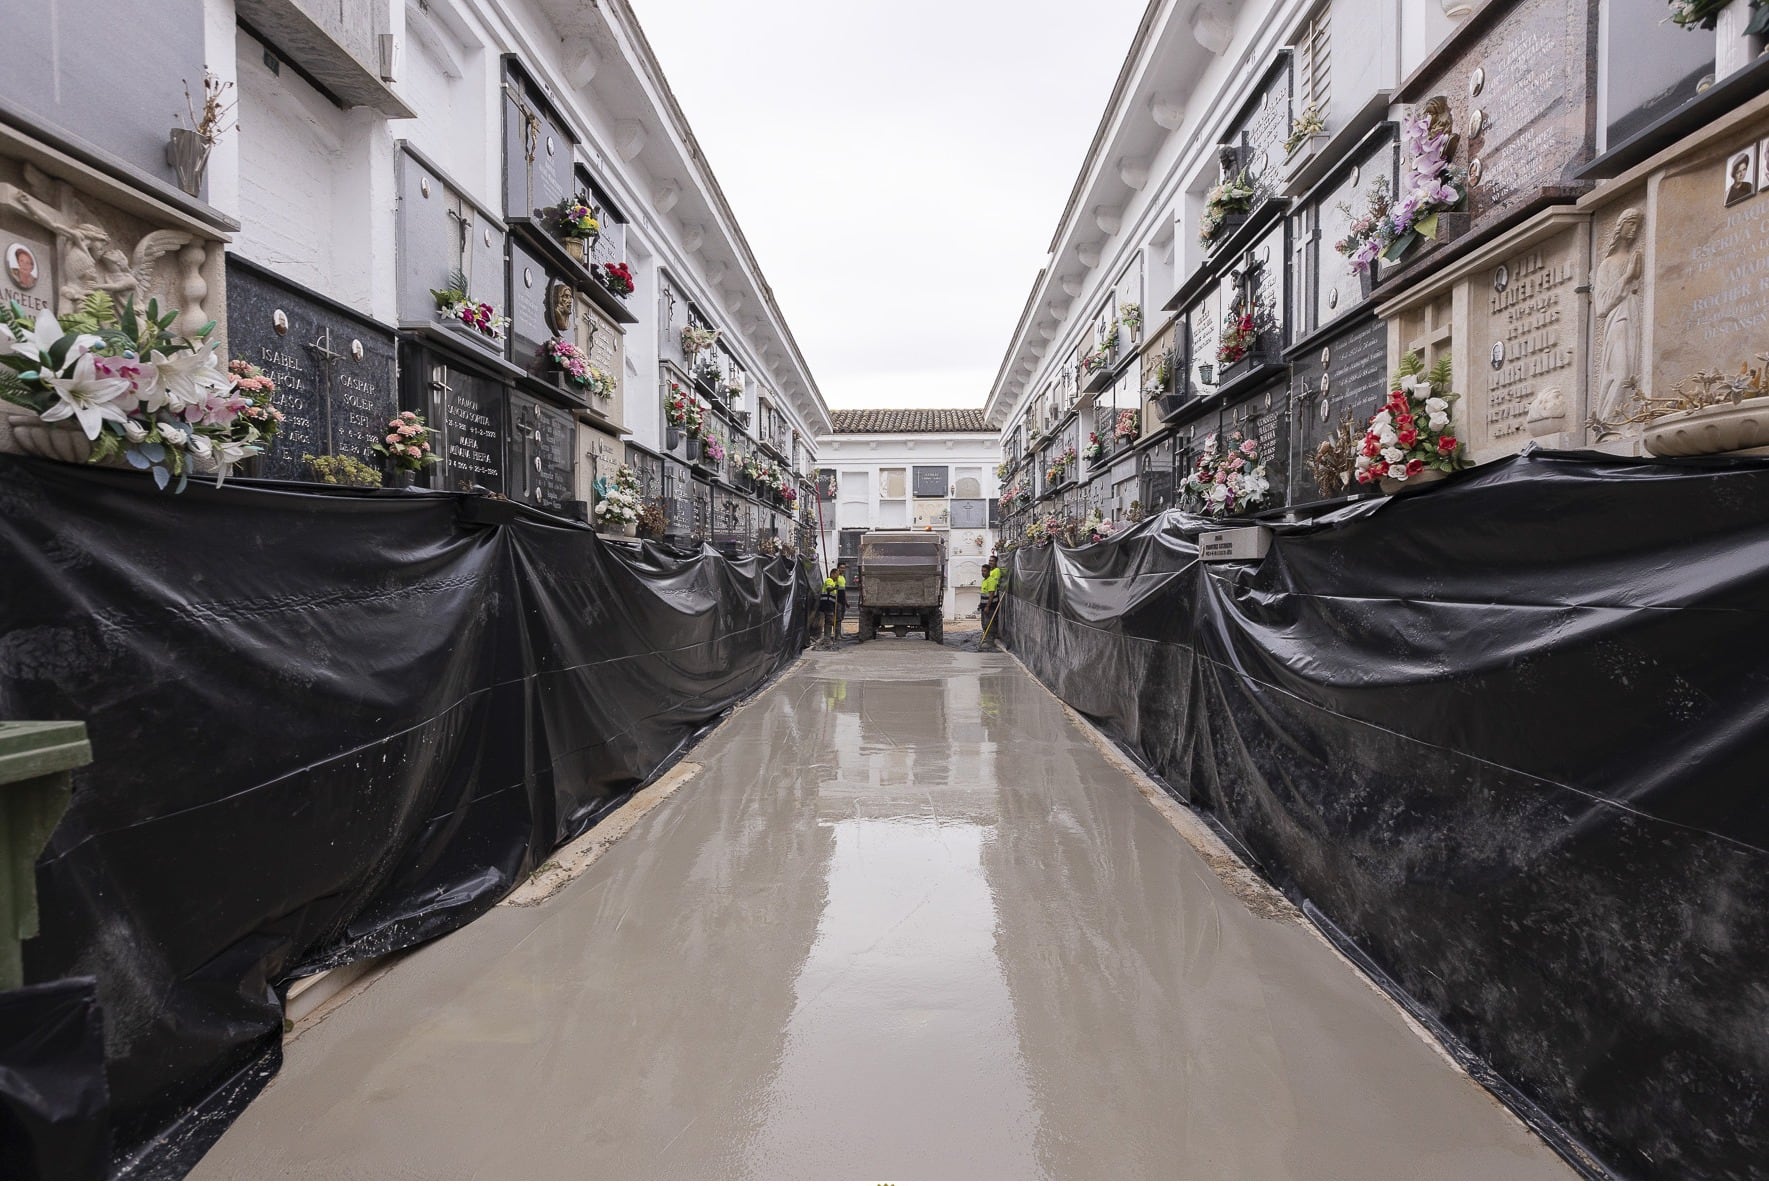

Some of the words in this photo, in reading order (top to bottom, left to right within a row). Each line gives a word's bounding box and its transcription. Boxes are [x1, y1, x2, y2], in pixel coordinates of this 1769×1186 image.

[262, 346, 303, 371] ISABEL
[340, 374, 376, 395] GASPAR
[344, 393, 374, 411] SOLER
